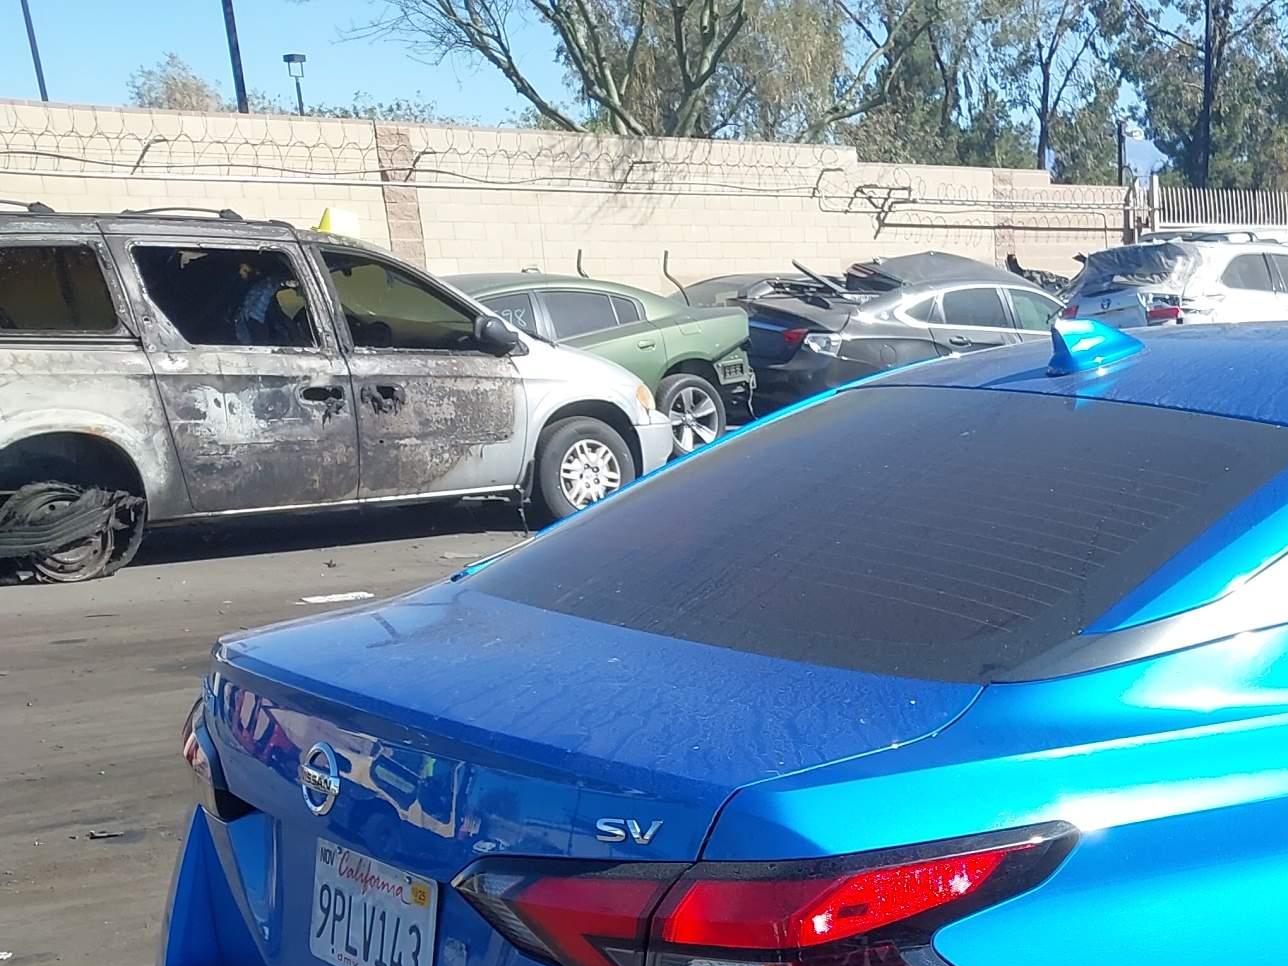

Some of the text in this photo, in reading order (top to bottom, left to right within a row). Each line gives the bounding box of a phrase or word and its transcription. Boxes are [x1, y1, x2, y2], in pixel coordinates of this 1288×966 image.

[302, 769, 332, 791] ISSAN
[595, 817, 664, 845] SV
[320, 847, 337, 866] NOV
[338, 849, 411, 905] California
